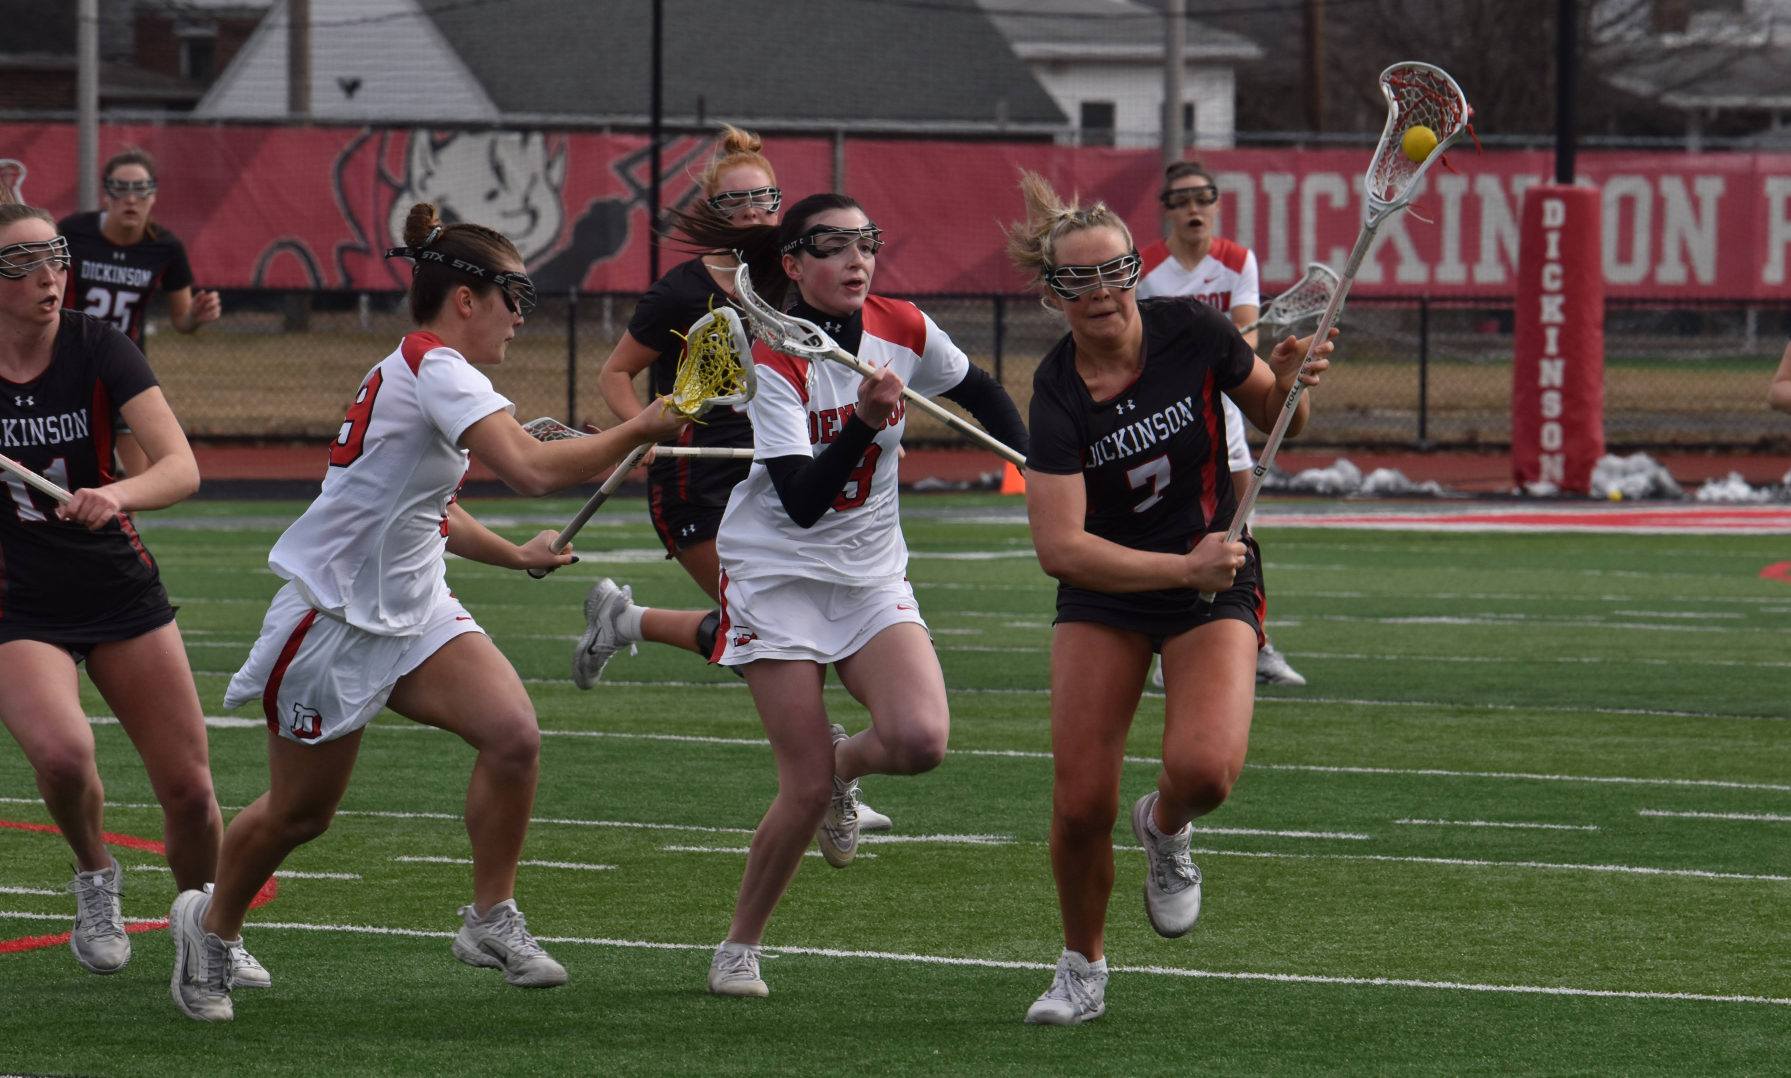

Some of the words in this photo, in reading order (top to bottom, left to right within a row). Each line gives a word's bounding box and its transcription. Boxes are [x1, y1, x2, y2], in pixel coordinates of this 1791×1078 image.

[1208, 173, 1725, 285] DICKINON
[81, 260, 152, 287] DICKINSON
[421, 251, 446, 263] STX
[452, 258, 486, 277] STX
[83, 286, 141, 333] 25
[1538, 198, 1566, 482] DICKINSON
[1285, 385, 1300, 408] ROLL
[0, 408, 89, 447] KINSON
[1126, 452, 1172, 513] 7
